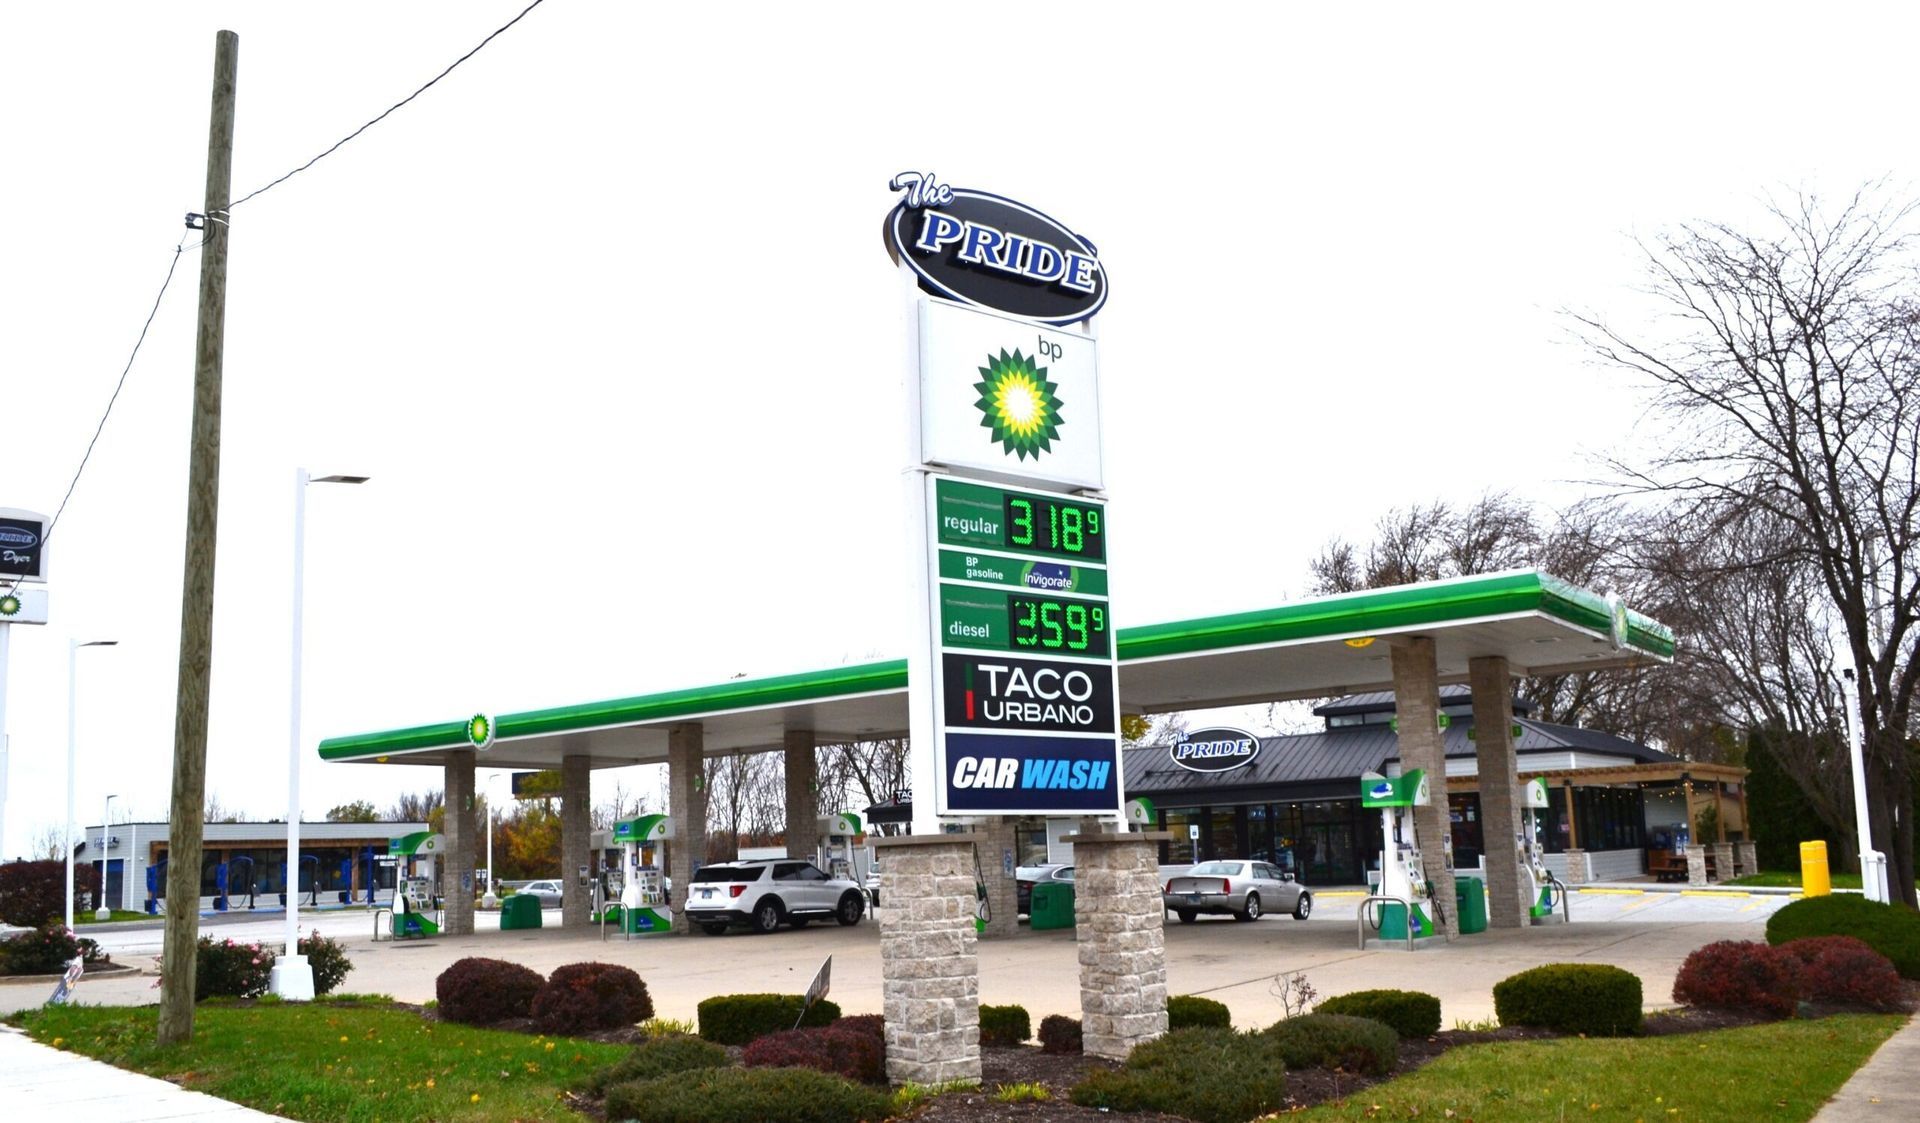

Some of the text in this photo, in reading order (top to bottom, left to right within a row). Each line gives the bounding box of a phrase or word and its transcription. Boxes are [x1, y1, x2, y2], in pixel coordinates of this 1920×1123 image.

[890, 171, 954, 206] The
[916, 209, 1098, 293] PRIDE
[1038, 335, 1063, 362] bp
[945, 516, 998, 535] regular
[3, 550, 31, 564] Dyer
[966, 556, 979, 567] BP
[966, 569, 1004, 581] gasoline
[1024, 572, 1073, 589] Invigorate
[949, 621, 990, 638] diesel
[978, 664, 1093, 702] TACO
[983, 700, 1094, 725] URBANO
[1176, 739, 1252, 760] PRIDE
[952, 756, 1111, 791] CAR WASH
[896, 790, 912, 799] TAC
